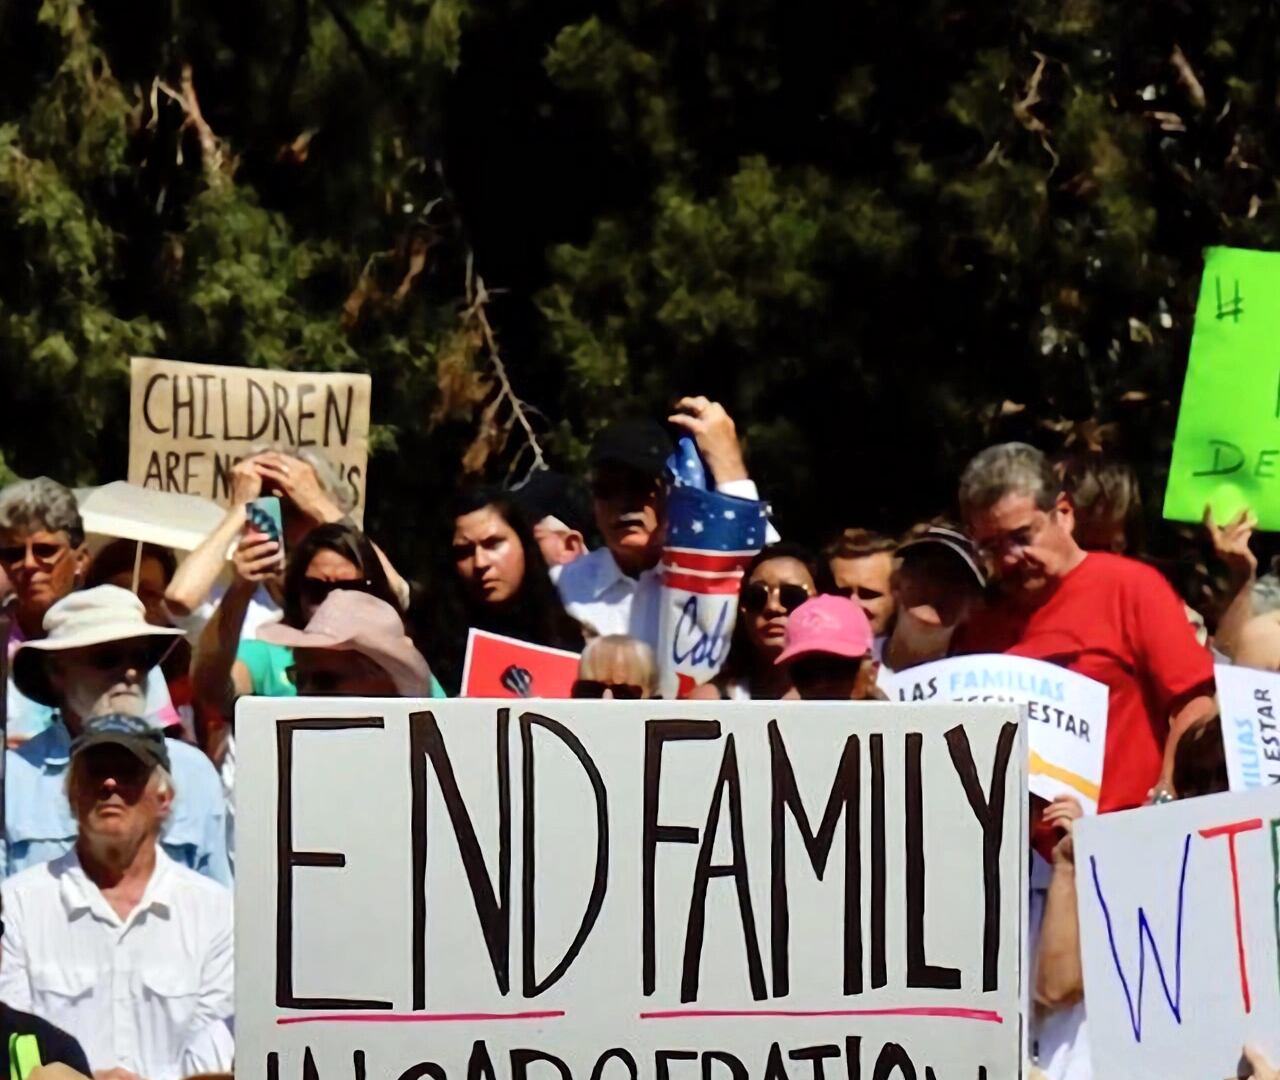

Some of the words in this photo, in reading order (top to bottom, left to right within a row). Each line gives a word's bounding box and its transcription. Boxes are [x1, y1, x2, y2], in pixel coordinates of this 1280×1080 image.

[142, 372, 354, 448] CHILDREN
[143, 450, 206, 496] ARE
[949, 668, 1066, 702] FAMILIAS
[1028, 700, 1091, 744] ESTAR
[274, 707, 609, 1012] END
[641, 717, 1019, 1005] FAMILY
